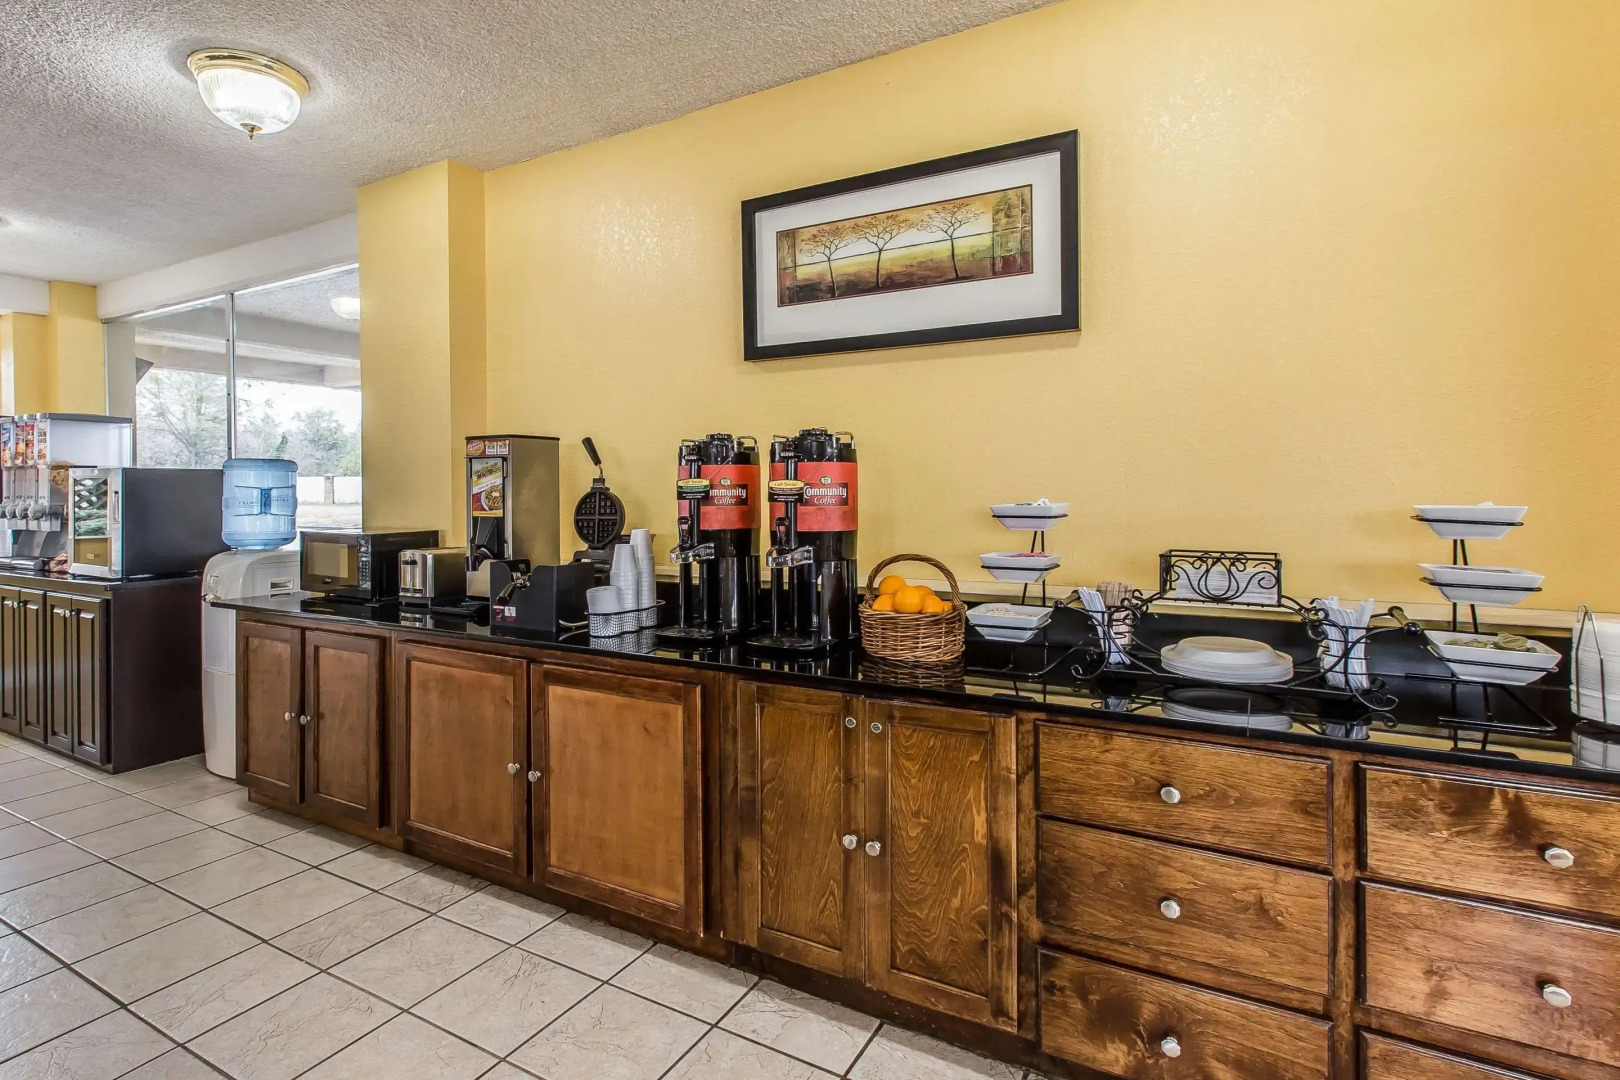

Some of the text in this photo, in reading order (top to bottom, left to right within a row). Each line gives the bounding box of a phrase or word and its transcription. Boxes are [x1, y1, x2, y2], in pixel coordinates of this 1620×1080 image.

[804, 485, 847, 499] Community
[714, 496, 737, 505] Coffee
[814, 495, 837, 505] Coffee
